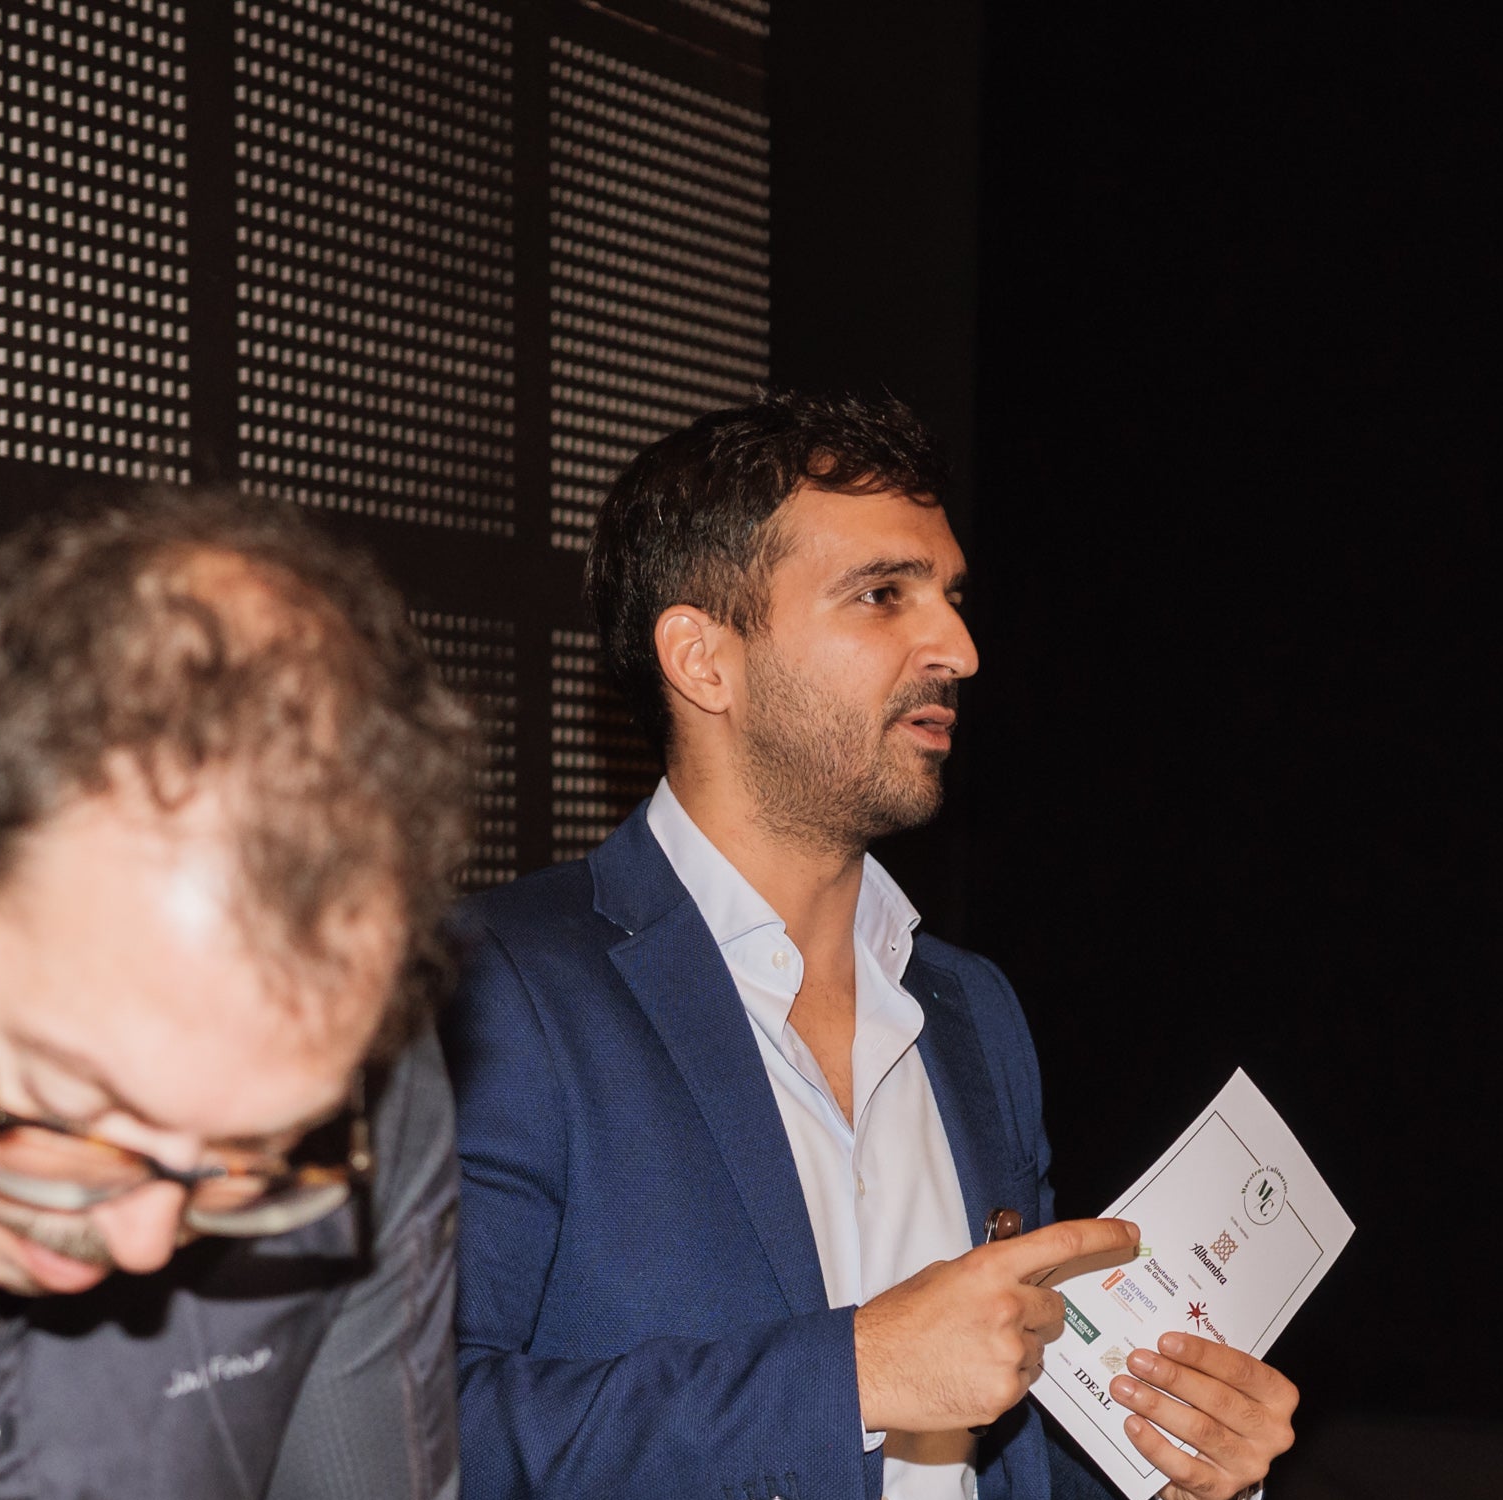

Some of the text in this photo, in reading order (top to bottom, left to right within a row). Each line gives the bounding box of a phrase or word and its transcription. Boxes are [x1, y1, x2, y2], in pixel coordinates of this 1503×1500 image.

[1143, 1264, 1152, 1274] de
[1151, 1270, 1176, 1297] Granada
[1148, 1258, 1179, 1291] Diputación
[1189, 1243, 1228, 1286] Alhambra
[1116, 1284, 1136, 1304] 2031
[1078, 1317, 1096, 1339] RURAL
[1073, 1367, 1114, 1411] IDEAL
